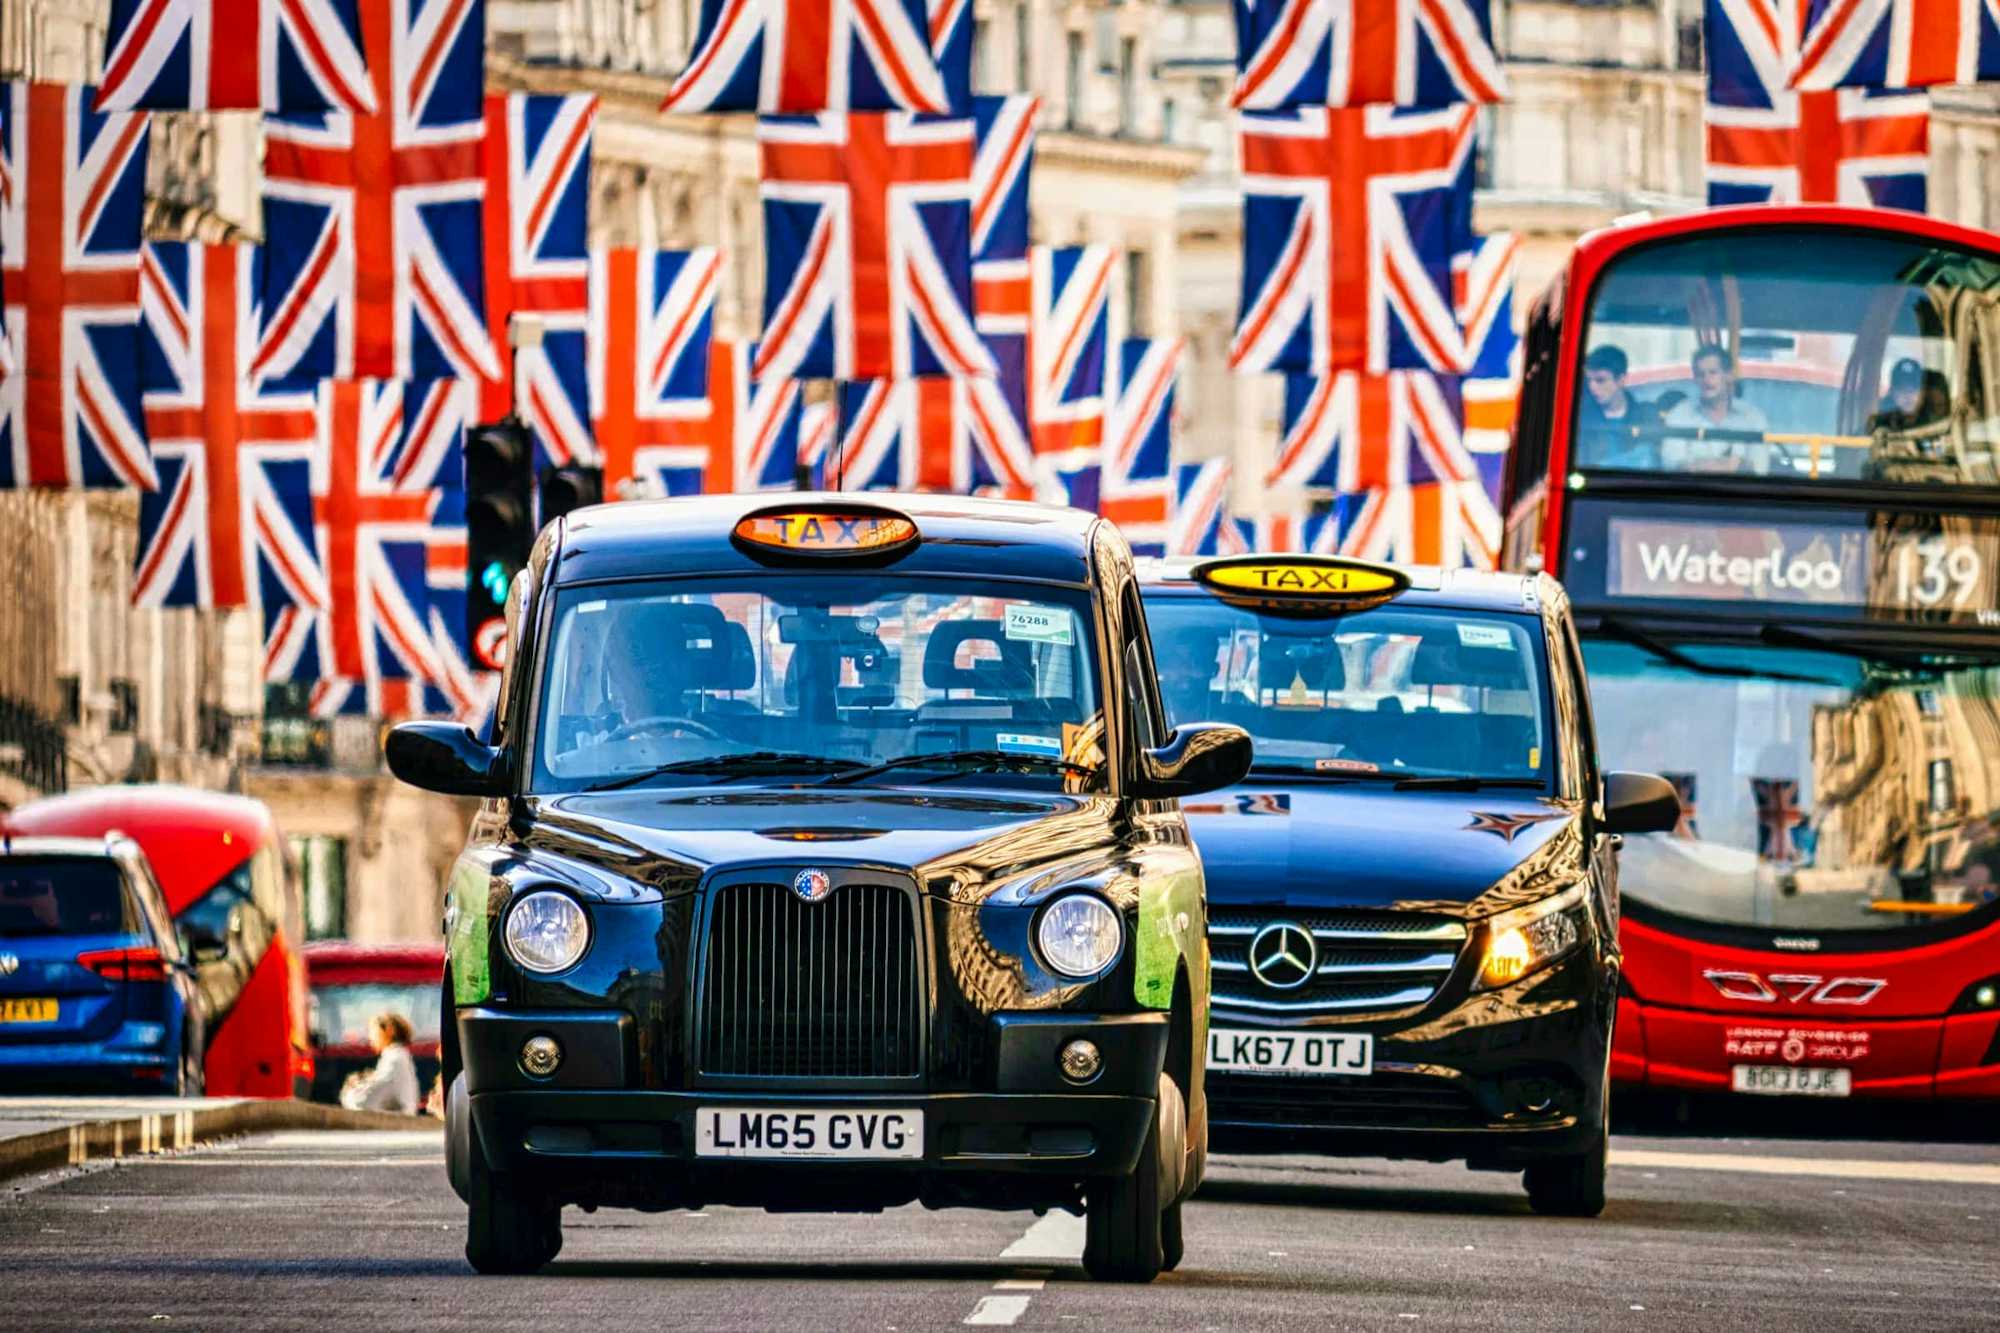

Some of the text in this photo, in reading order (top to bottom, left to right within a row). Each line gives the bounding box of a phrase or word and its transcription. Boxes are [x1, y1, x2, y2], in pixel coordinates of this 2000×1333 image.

[773, 517, 878, 544] TAXI
[1252, 569, 1349, 590] TAXI
[1638, 541, 1981, 606] Waterloo 139
[1010, 614, 1049, 626] 76288
[1212, 1034, 1367, 1068] LK67 OTJ
[713, 1113, 905, 1150] LM65 GVG
